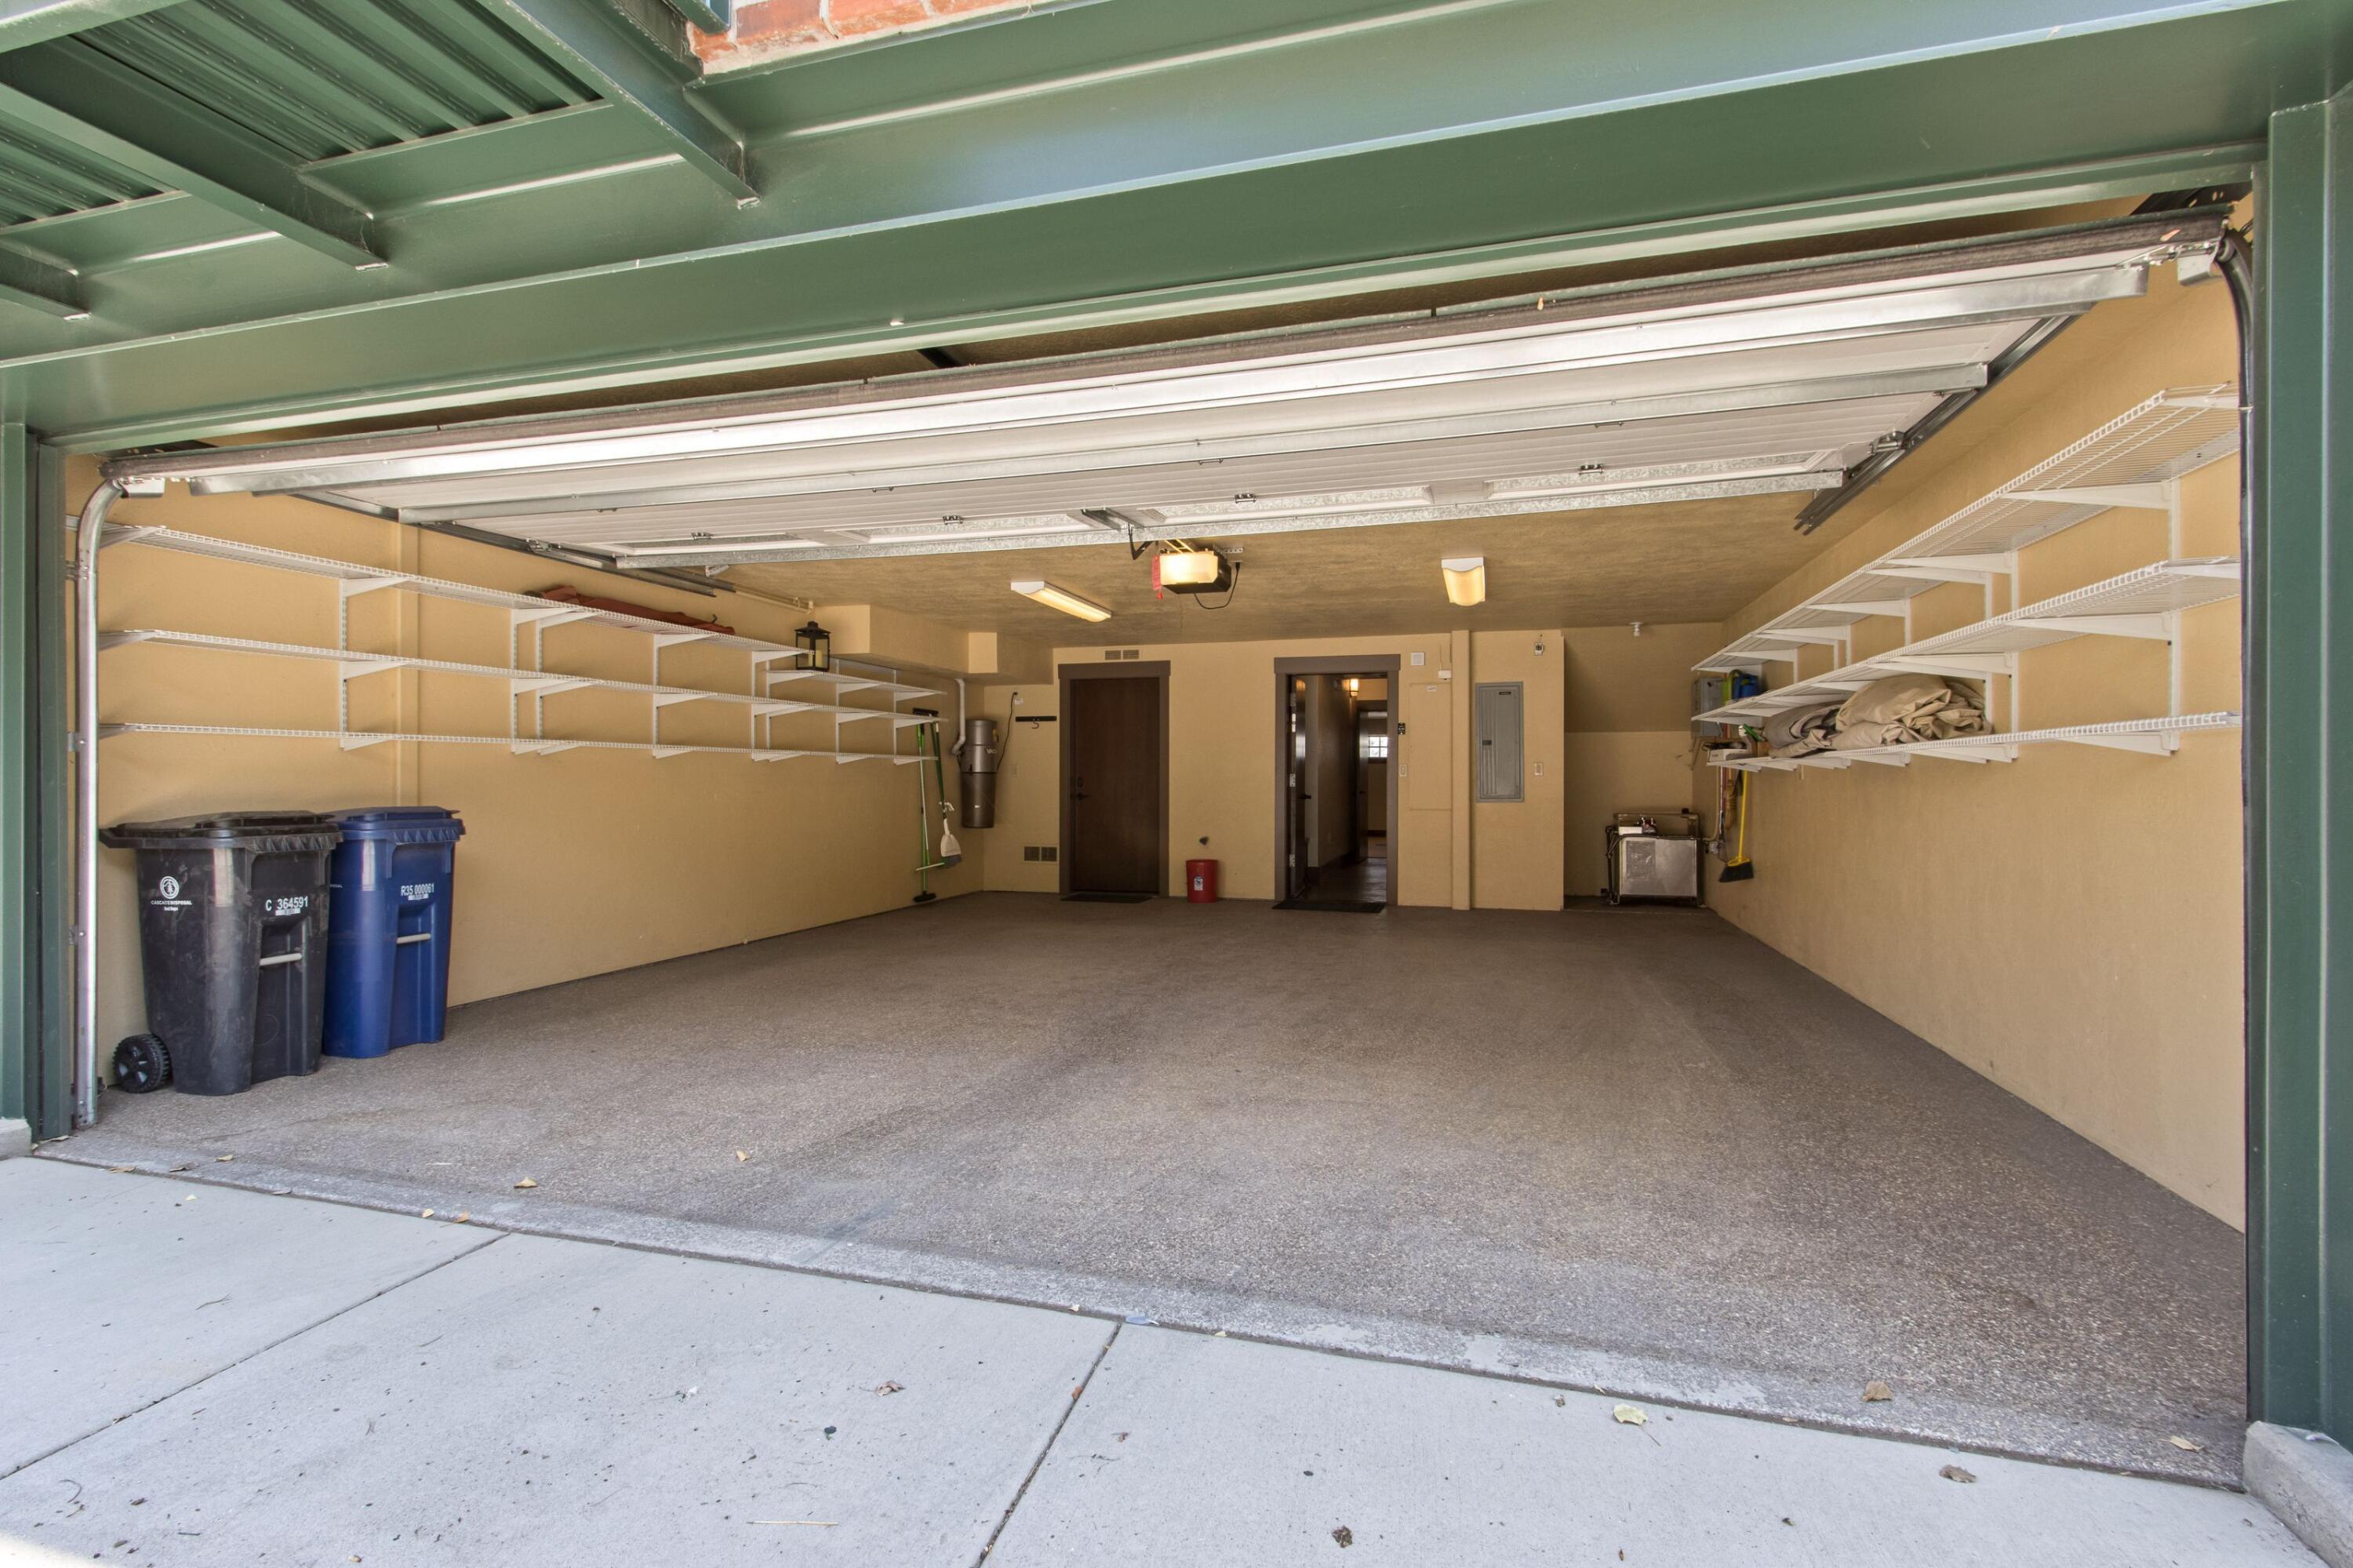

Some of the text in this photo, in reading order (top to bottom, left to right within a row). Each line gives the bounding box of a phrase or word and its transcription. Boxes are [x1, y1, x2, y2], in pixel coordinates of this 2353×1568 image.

[401, 885, 413, 896] R35
[265, 896, 308, 911] C 364591
